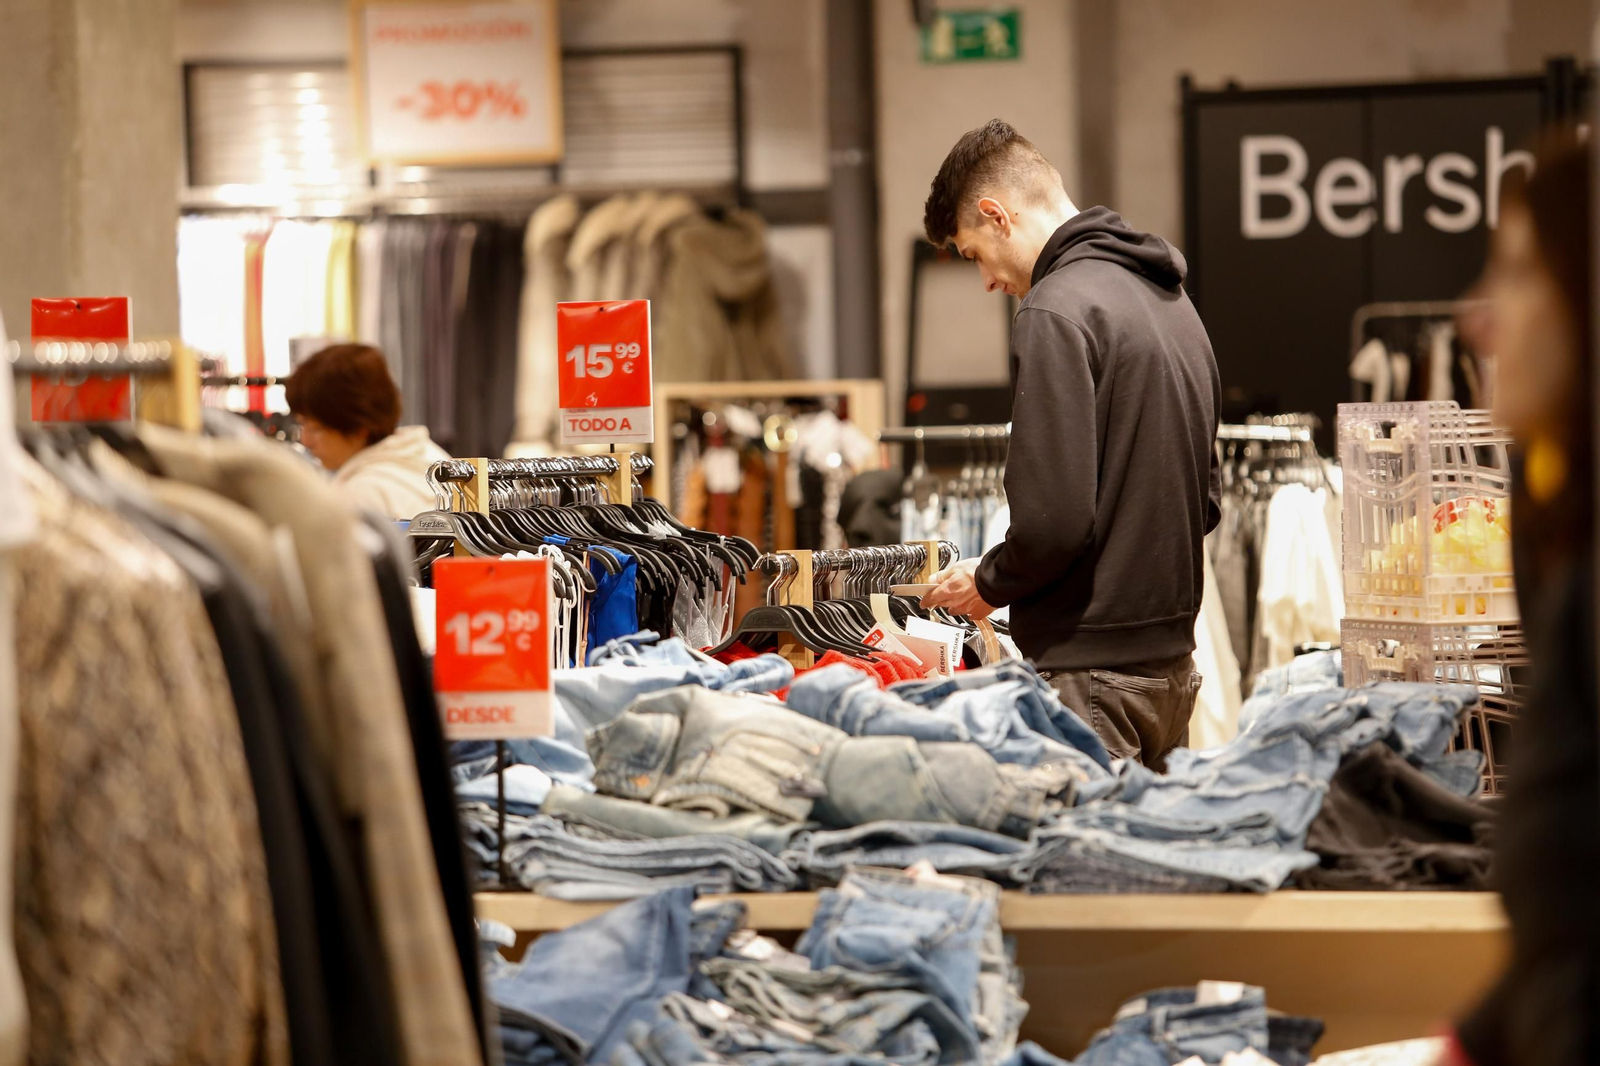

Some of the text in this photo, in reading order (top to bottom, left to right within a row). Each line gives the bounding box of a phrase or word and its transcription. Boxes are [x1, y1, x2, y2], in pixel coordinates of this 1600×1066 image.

[395, 81, 528, 121] -30%
[1240, 126, 1536, 239] Bersh
[568, 417, 632, 432] TODO A
[952, 632, 960, 662] BERSHKA
[446, 706, 516, 724] DESDE
